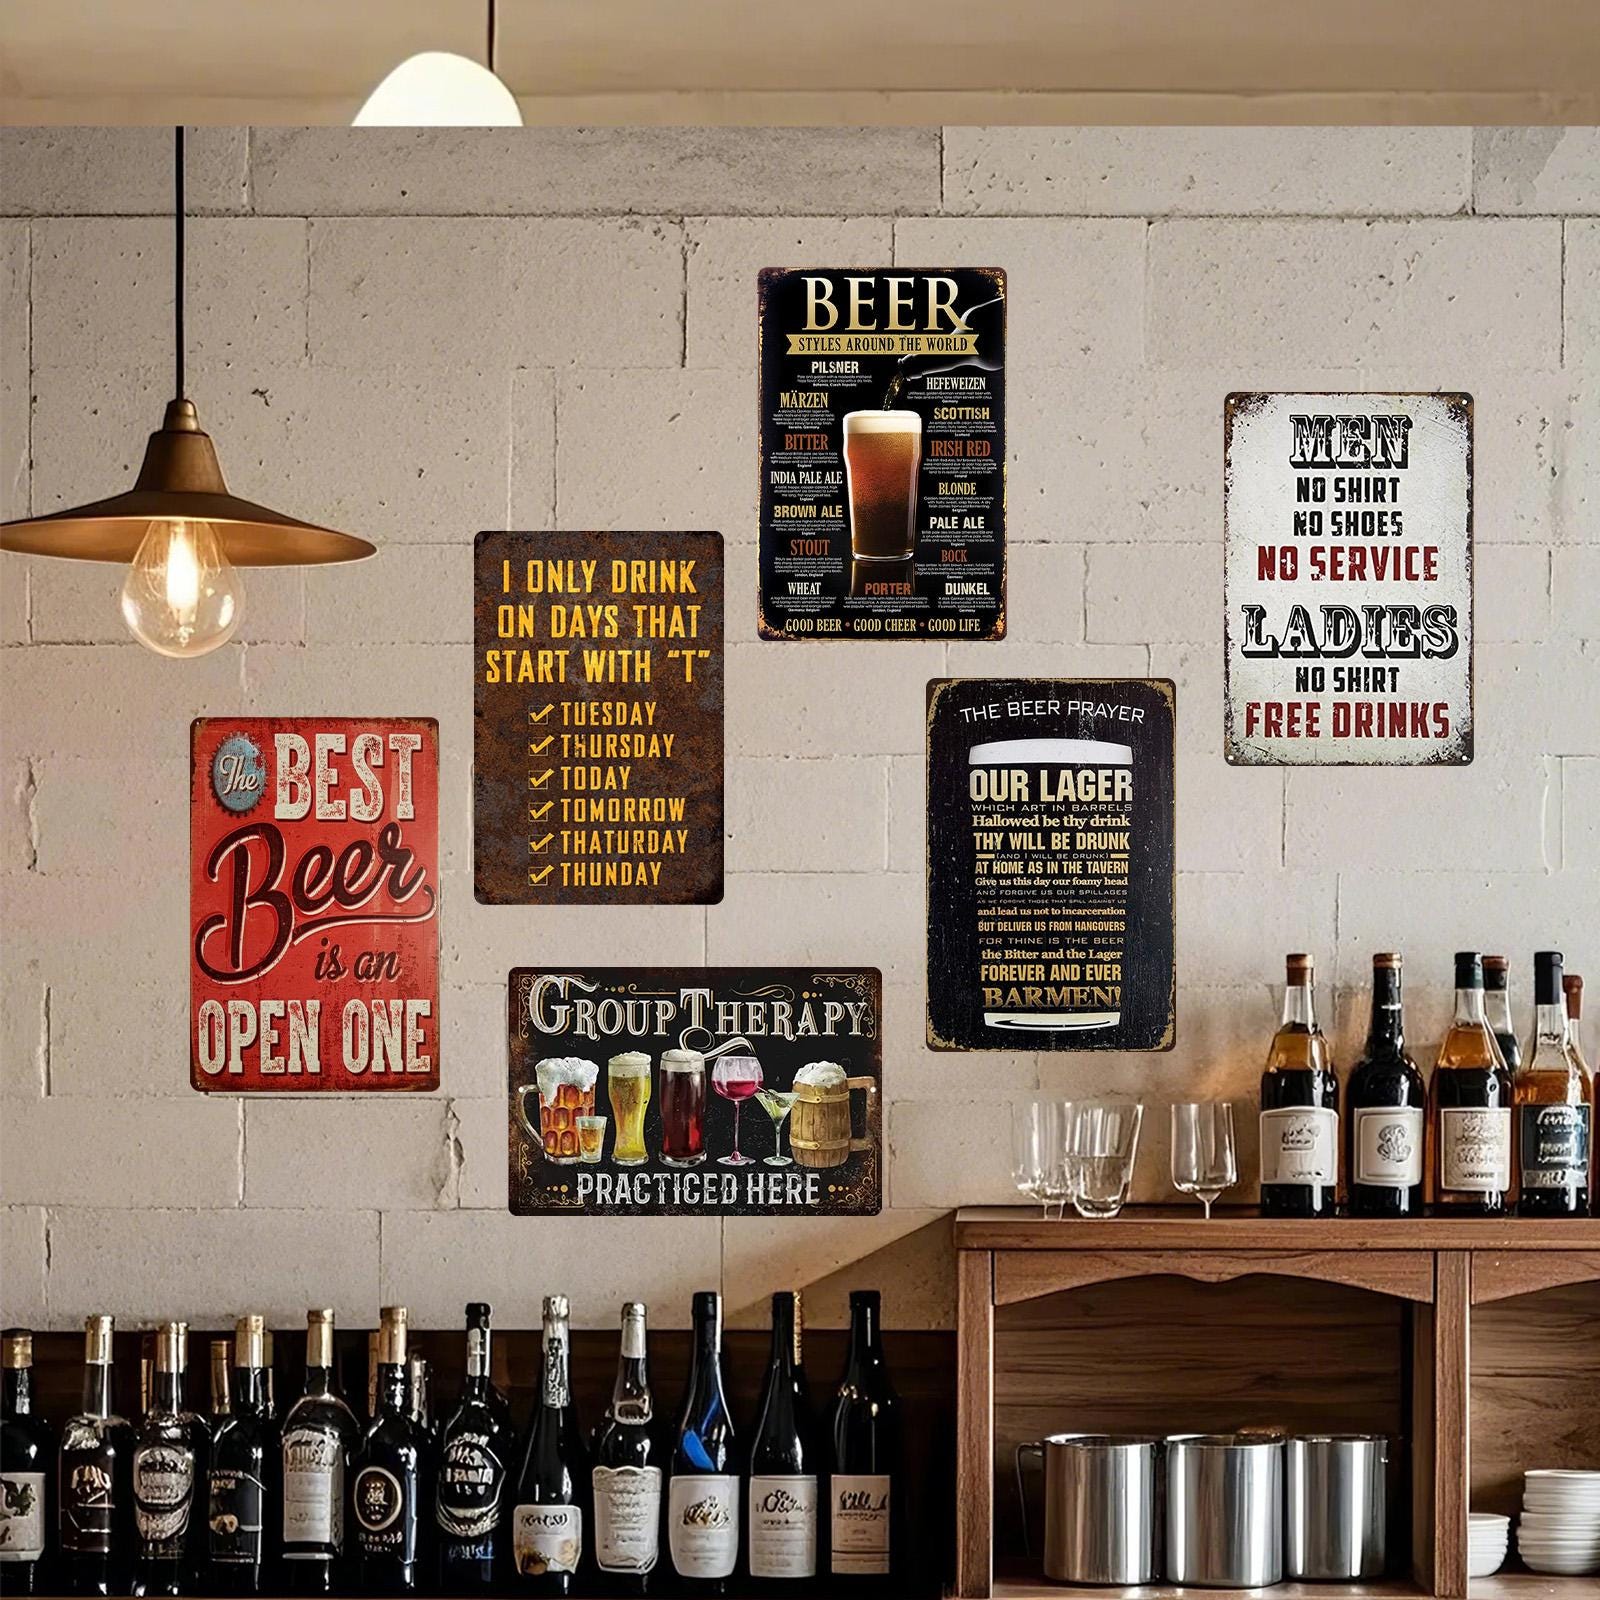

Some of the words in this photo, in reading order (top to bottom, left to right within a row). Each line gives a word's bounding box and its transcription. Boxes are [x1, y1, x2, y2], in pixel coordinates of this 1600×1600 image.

[801, 277, 974, 331] BEER
[798, 337, 841, 352] STYLES
[847, 337, 894, 352] AROUND
[899, 337, 920, 352] THE
[926, 337, 968, 352] WORLD
[811, 361, 859, 373] PILSNER
[927, 377, 986, 390] HEFEWEIZEN
[780, 390, 828, 408] MÄRZEN
[934, 407, 990, 419] SCOTTISH
[785, 434, 828, 450] BITTER
[931, 440, 962, 456] IRISH
[967, 440, 990, 456] RED
[1289, 415, 1413, 469] MEN
[771, 471, 797, 484] INDIA
[800, 471, 822, 484] PALE
[825, 471, 842, 484] ALE
[939, 483, 976, 495] BLONDE
[1297, 477, 1326, 503] NO
[1334, 477, 1400, 503] SHIRT
[774, 505, 816, 517] BROWN
[821, 505, 843, 517] ALE
[930, 517, 958, 529] PALE
[963, 517, 984, 529] ALE
[1294, 511, 1322, 536] NO
[1331, 511, 1403, 536] SHOES
[790, 539, 830, 556] STOUT
[941, 550, 967, 562] BOCK
[1258, 546, 1298, 580] NO
[1310, 546, 1438, 580] SERVICE
[503, 560, 509, 593] I
[527, 560, 597, 593] ONLY
[612, 560, 696, 593] DRINK
[788, 582, 821, 595] WHEAT
[865, 583, 911, 595] PORTER
[945, 583, 990, 595] DUNKEL
[498, 605, 534, 638] ON
[551, 605, 618, 638] DAYS
[633, 605, 701, 638] THAT
[786, 619, 813, 631] GOOD
[817, 619, 842, 631] BEER
[854, 619, 881, 631] GOOD
[886, 619, 916, 631] CHEER
[928, 619, 955, 631] GOOD
[959, 619, 980, 631] LIFE
[1242, 605, 1459, 659] LADIES
[486, 650, 569, 683] START
[583, 650, 650, 683] WITH
[1296, 667, 1325, 693] NO
[1334, 667, 1399, 693] SHIRT
[561, 702, 656, 725] TUESDAY
[960, 704, 1001, 723] THE
[1008, 700, 1061, 717] BEER
[1067, 700, 1145, 724] PRAYER
[1245, 702, 1321, 738] FREE
[1332, 702, 1449, 738] DRINKS
[561, 734, 674, 757] THURSDAY
[220, 755, 258, 794] The
[274, 733, 422, 821] BEST
[561, 766, 631, 790] TODAY
[970, 769, 1028, 802] OUR
[1040, 769, 1133, 802] LAGER
[561, 798, 685, 822] TOMORROW
[972, 804, 1015, 812] WHICH
[1021, 804, 1046, 812] ART
[1053, 804, 1065, 812] IN
[1072, 804, 1132, 812] BARRELS
[972, 815, 1040, 827] Hallowed
[1043, 815, 1060, 827] be
[1063, 815, 1088, 829] thy
[1090, 815, 1131, 827] drink
[561, 830, 688, 854] THATURDAY
[973, 832, 1004, 850] THY
[1009, 832, 1045, 850] WILL
[1052, 832, 1070, 850] BE
[1076, 832, 1130, 850] DRUNK
[561, 862, 661, 886] THUNDAY
[975, 861, 988, 874] AT
[993, 861, 1024, 874] HOME
[1028, 861, 1043, 874] AS
[1047, 861, 1058, 874] IN
[1062, 861, 1082, 874] THE
[1086, 861, 1129, 874] TAVERN
[975, 877, 997, 886] Give
[1013, 877, 1031, 886] this
[1034, 877, 1050, 887] day
[1072, 877, 1102, 887] foamy
[1104, 877, 1128, 886] head
[195, 822, 436, 984] Beer
[978, 907, 996, 915] and
[998, 907, 1018, 915] lead
[1020, 907, 1031, 915] us
[1034, 907, 1049, 915] not
[1051, 907, 1061, 915] to
[1062, 907, 1125, 915] incarceration
[978, 921, 995, 931] BUT
[998, 921, 1032, 931] DELIVER
[1035, 921, 1046, 931] US
[1049, 921, 1072, 931] FROM
[1075, 921, 1125, 931] HANGOVERS
[314, 937, 348, 982] is
[353, 951, 402, 982] an
[982, 950, 1001, 959] the
[1004, 950, 1039, 959] Bitter
[1041, 950, 1064, 959] and
[1066, 950, 1086, 959] the
[1089, 950, 1123, 961] Lager
[980, 964, 1045, 981] FOREVER
[1050, 964, 1080, 981] AND
[1086, 964, 1121, 981] EVER
[982, 986, 1121, 1008] BARMEN!
[530, 975, 678, 1041] GROUP
[679, 988, 869, 1061] THERAPY
[199, 1000, 320, 1074] OPEN
[342, 999, 431, 1074] ONE
[576, 1173, 736, 1205] PRACTICED
[746, 1173, 821, 1205] HERE
